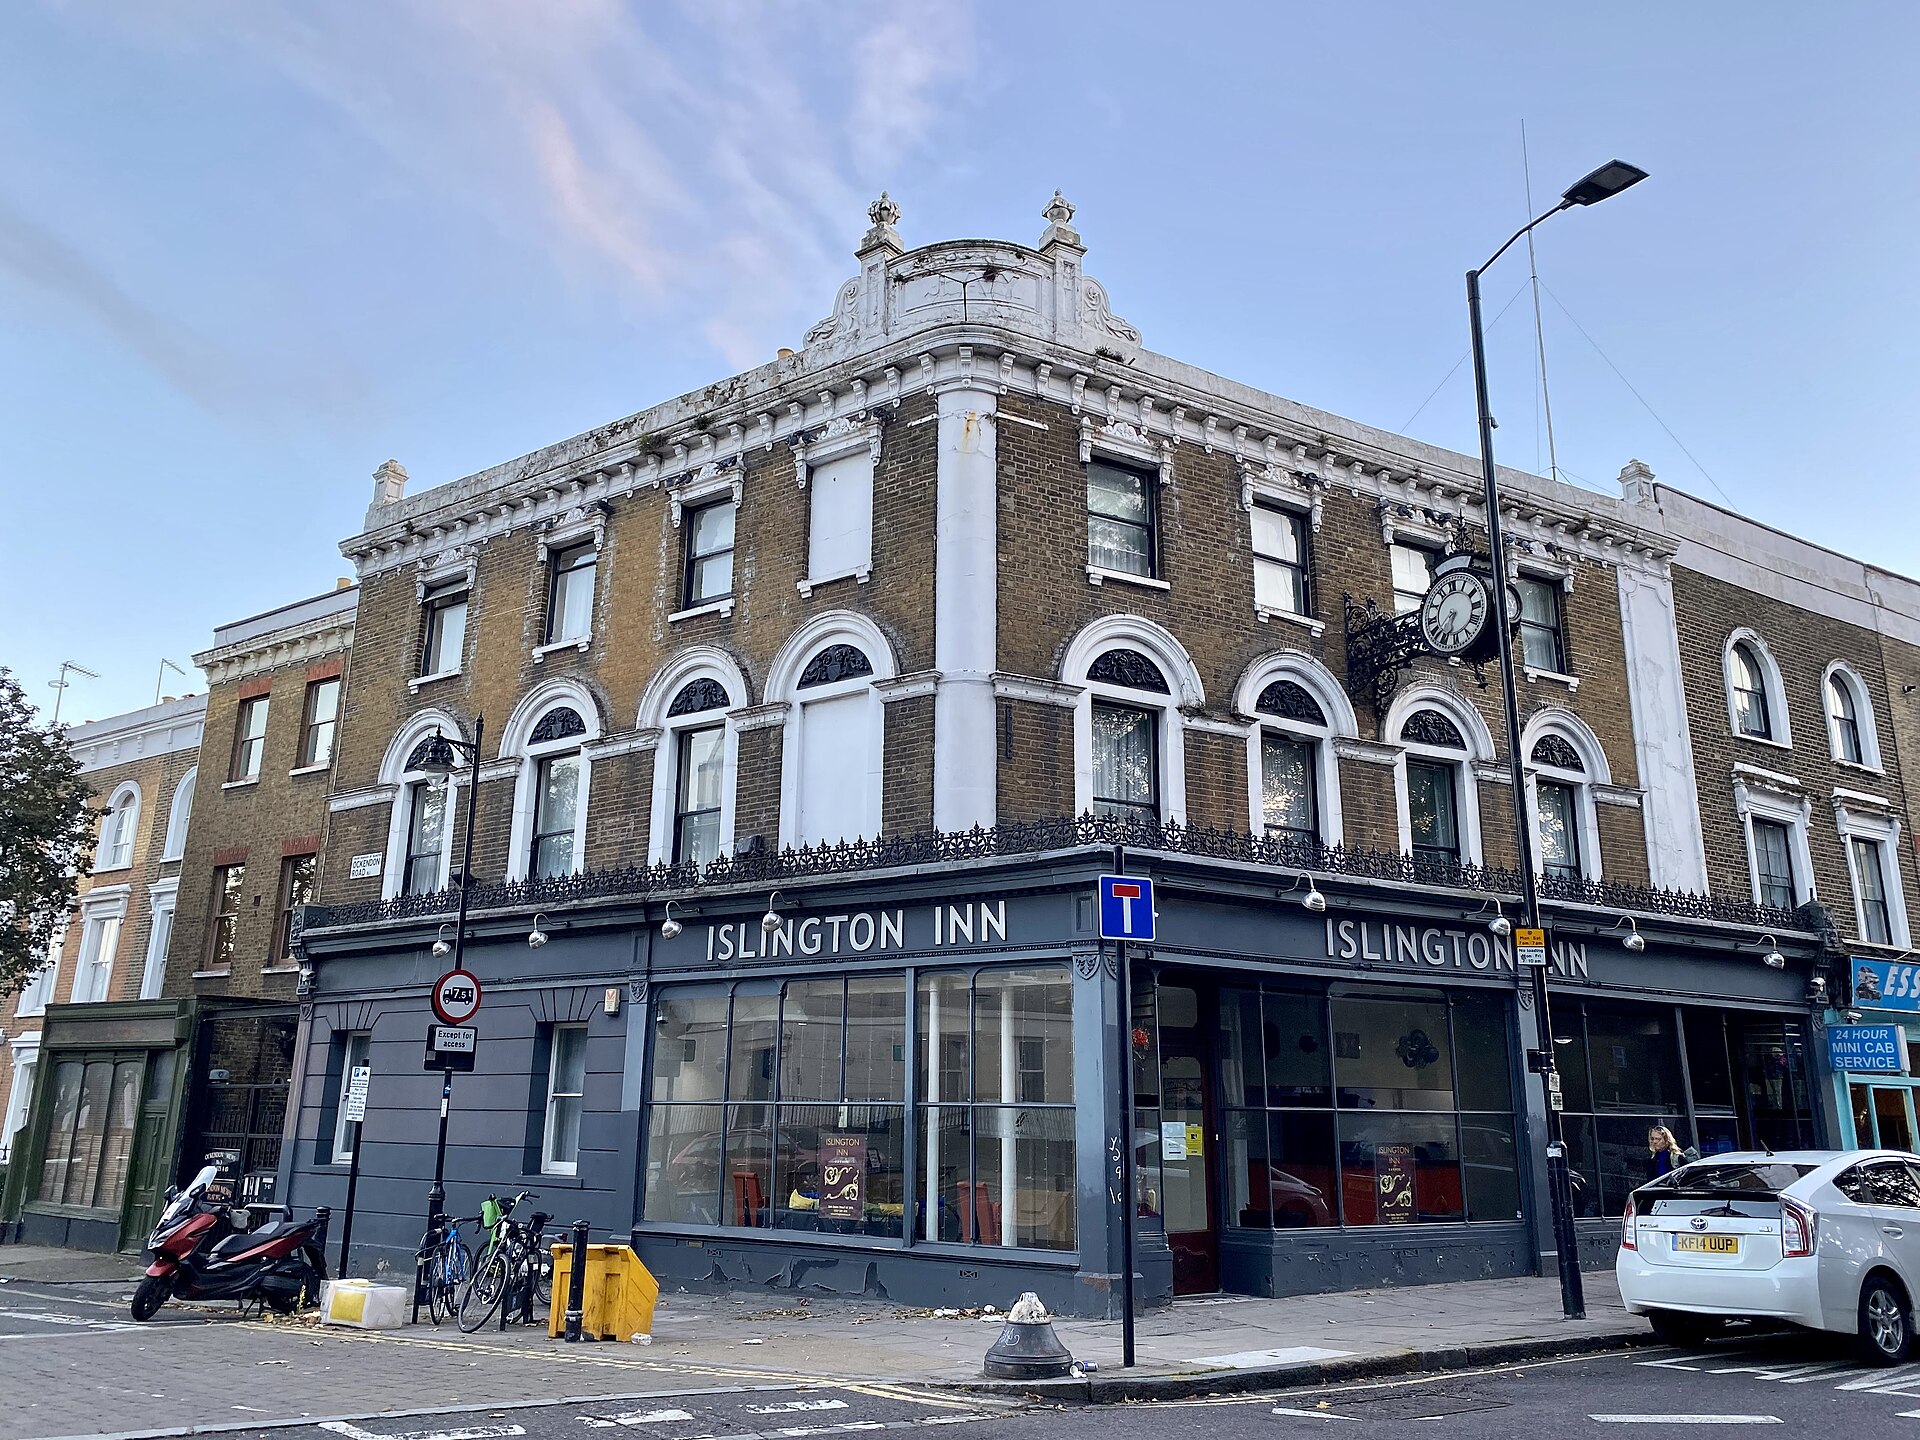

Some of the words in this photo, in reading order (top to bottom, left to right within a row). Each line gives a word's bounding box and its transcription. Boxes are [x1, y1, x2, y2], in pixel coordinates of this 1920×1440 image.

[352, 858, 381, 868] OCKENDON
[352, 868, 366, 877] ROAD
[706, 909, 904, 961] ISLINGTON
[933, 900, 1006, 945] INN
[1326, 918, 1515, 971] ISLINGTON
[1547, 941, 1589, 978] NN
[438, 1030, 461, 1040] Except
[462, 1031, 473, 1040] for
[1835, 1030, 1849, 1040] 24
[1852, 1030, 1888, 1040] HOUR
[1832, 1042, 1861, 1053] MINI
[1864, 1042, 1895, 1053] CAB
[1835, 1056, 1896, 1068] SERVICE
[825, 1138, 860, 1146] ISLINGTON
[1378, 1146, 1410, 1154] ISLINGTON
[1681, 1237, 1707, 1251] KF14
[1709, 1237, 1733, 1251] UUP
